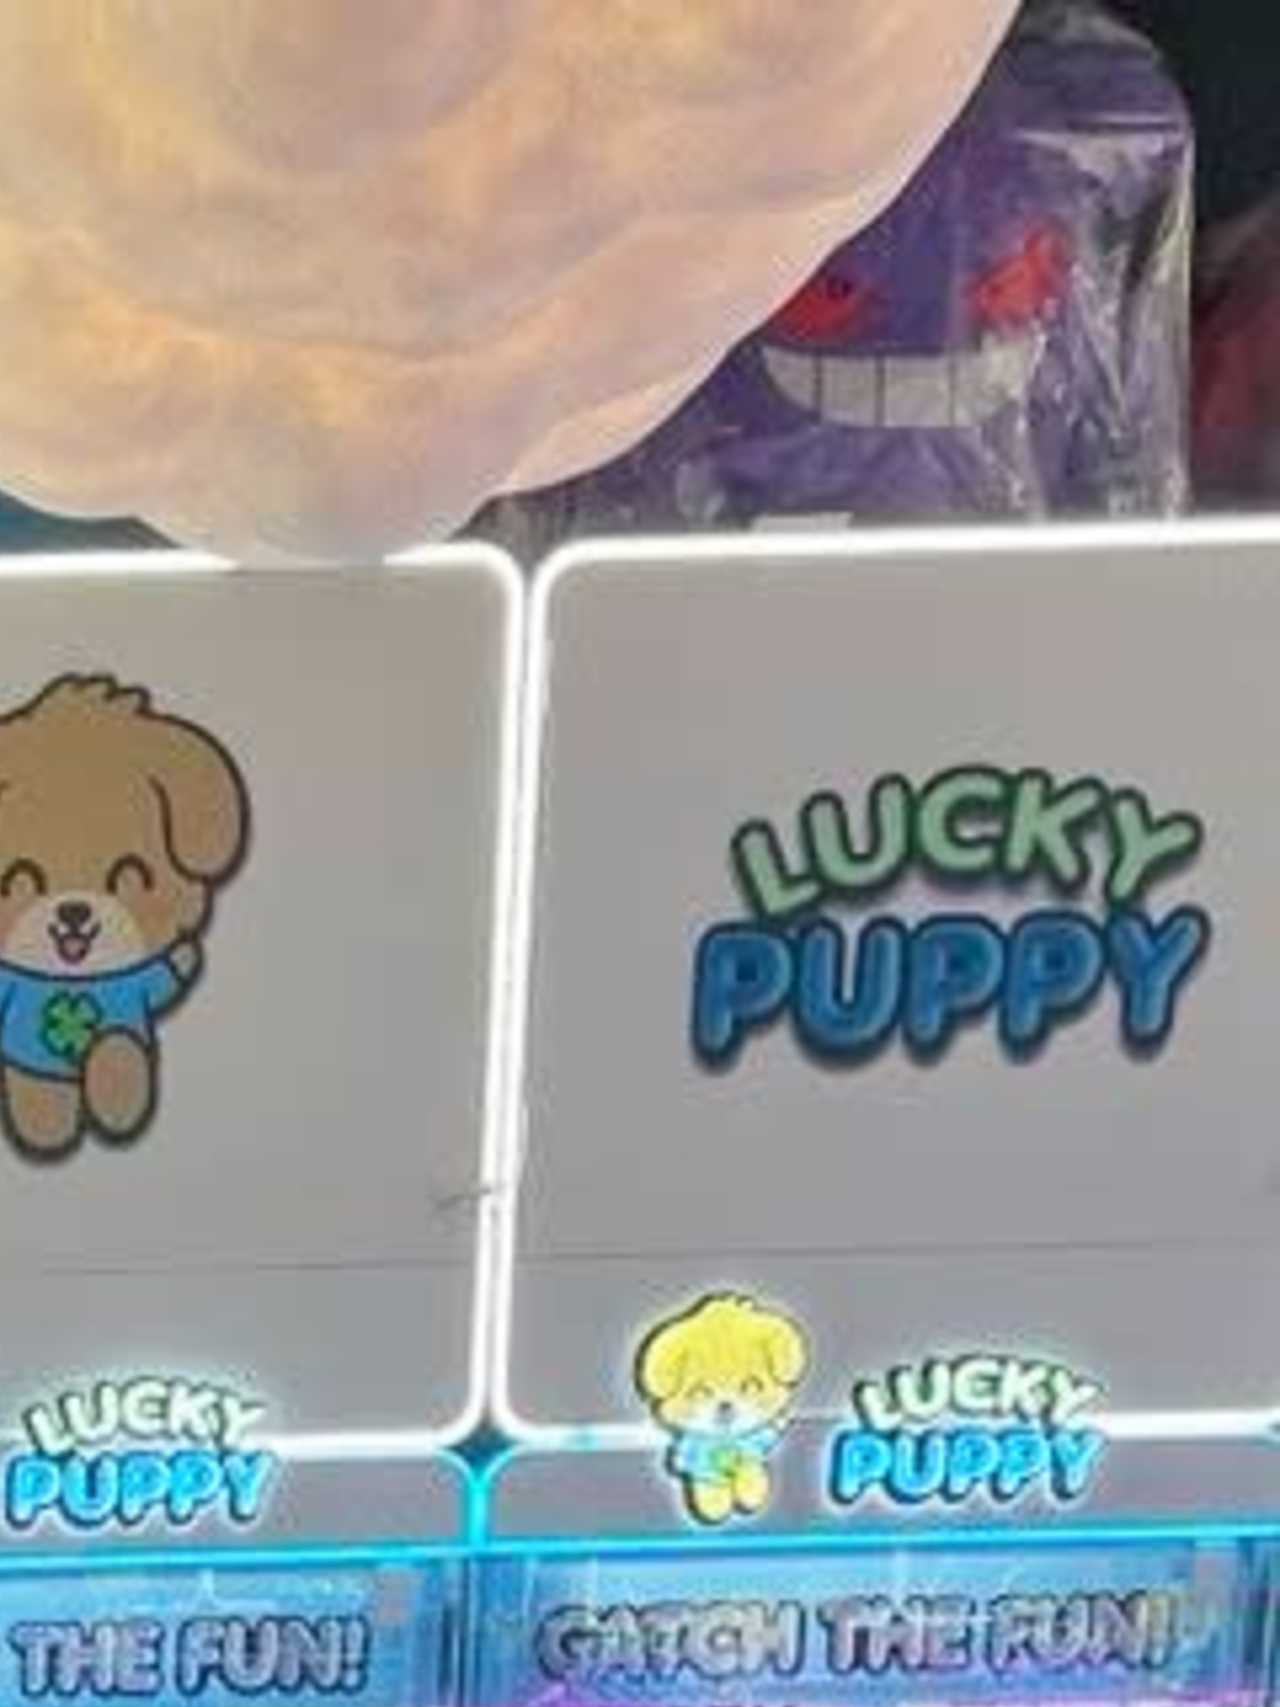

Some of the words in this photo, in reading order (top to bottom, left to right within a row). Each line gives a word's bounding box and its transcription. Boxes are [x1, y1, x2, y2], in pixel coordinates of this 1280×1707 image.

[730, 764, 1204, 921] LUCKY
[691, 903, 1211, 1075] PUPPY
[24, 1377, 265, 1453] LUCKY
[852, 1354, 1101, 1430] LUCKY
[4, 1449, 276, 1527] PUPPY
[830, 1428, 1106, 1504] PUPPY
[10, 1620, 166, 1700] THE
[176, 1614, 372, 1697] FUN!
[817, 1594, 988, 1676] THE
